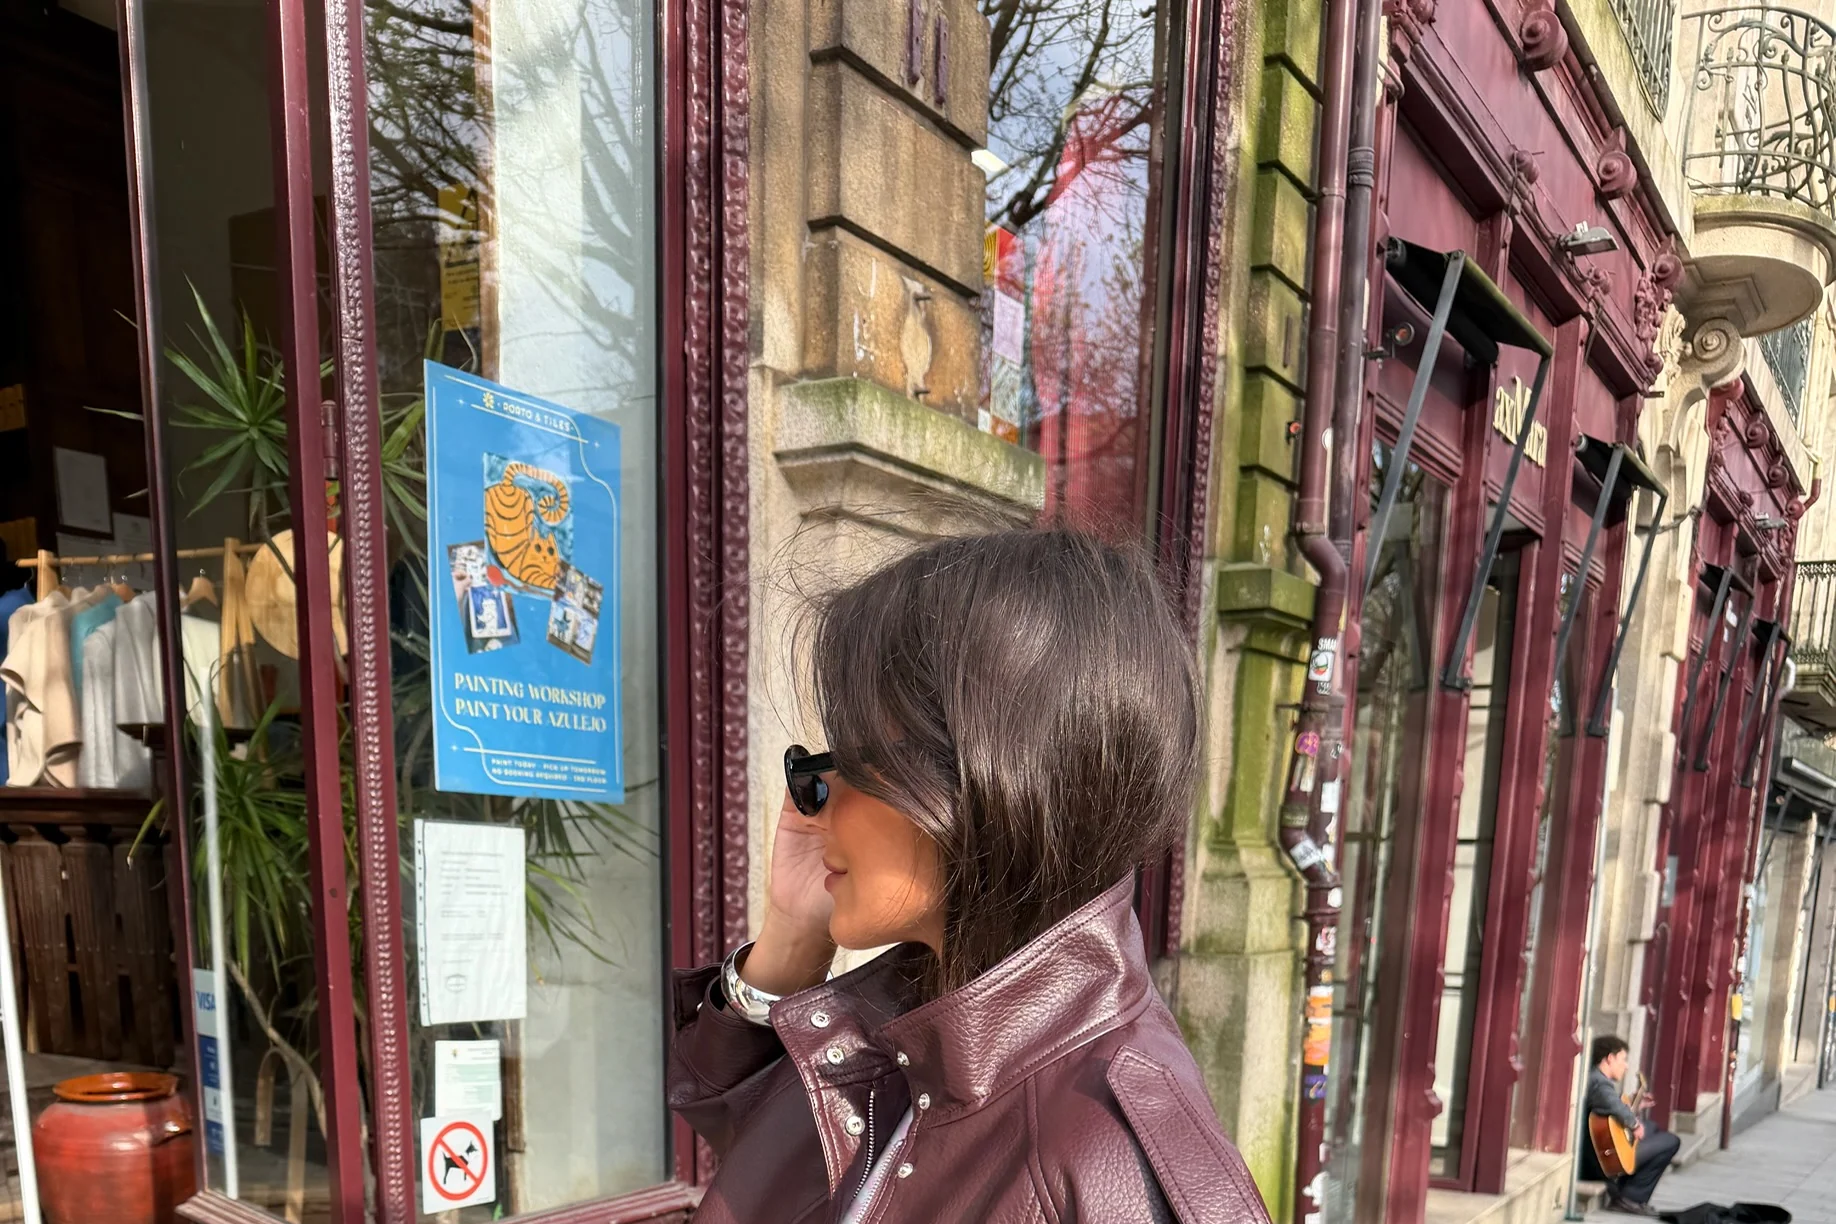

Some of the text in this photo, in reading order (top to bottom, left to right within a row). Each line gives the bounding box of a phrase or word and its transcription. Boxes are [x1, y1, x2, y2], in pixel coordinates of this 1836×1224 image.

[503, 402, 571, 432] PORTO & TILES
[454, 672, 606, 710] PAINTING WORKSHOP
[455, 698, 607, 733] PAINT YOUR AZULEJO
[514, 760, 536, 769] TODAY
[570, 765, 606, 775] TOMORROW
